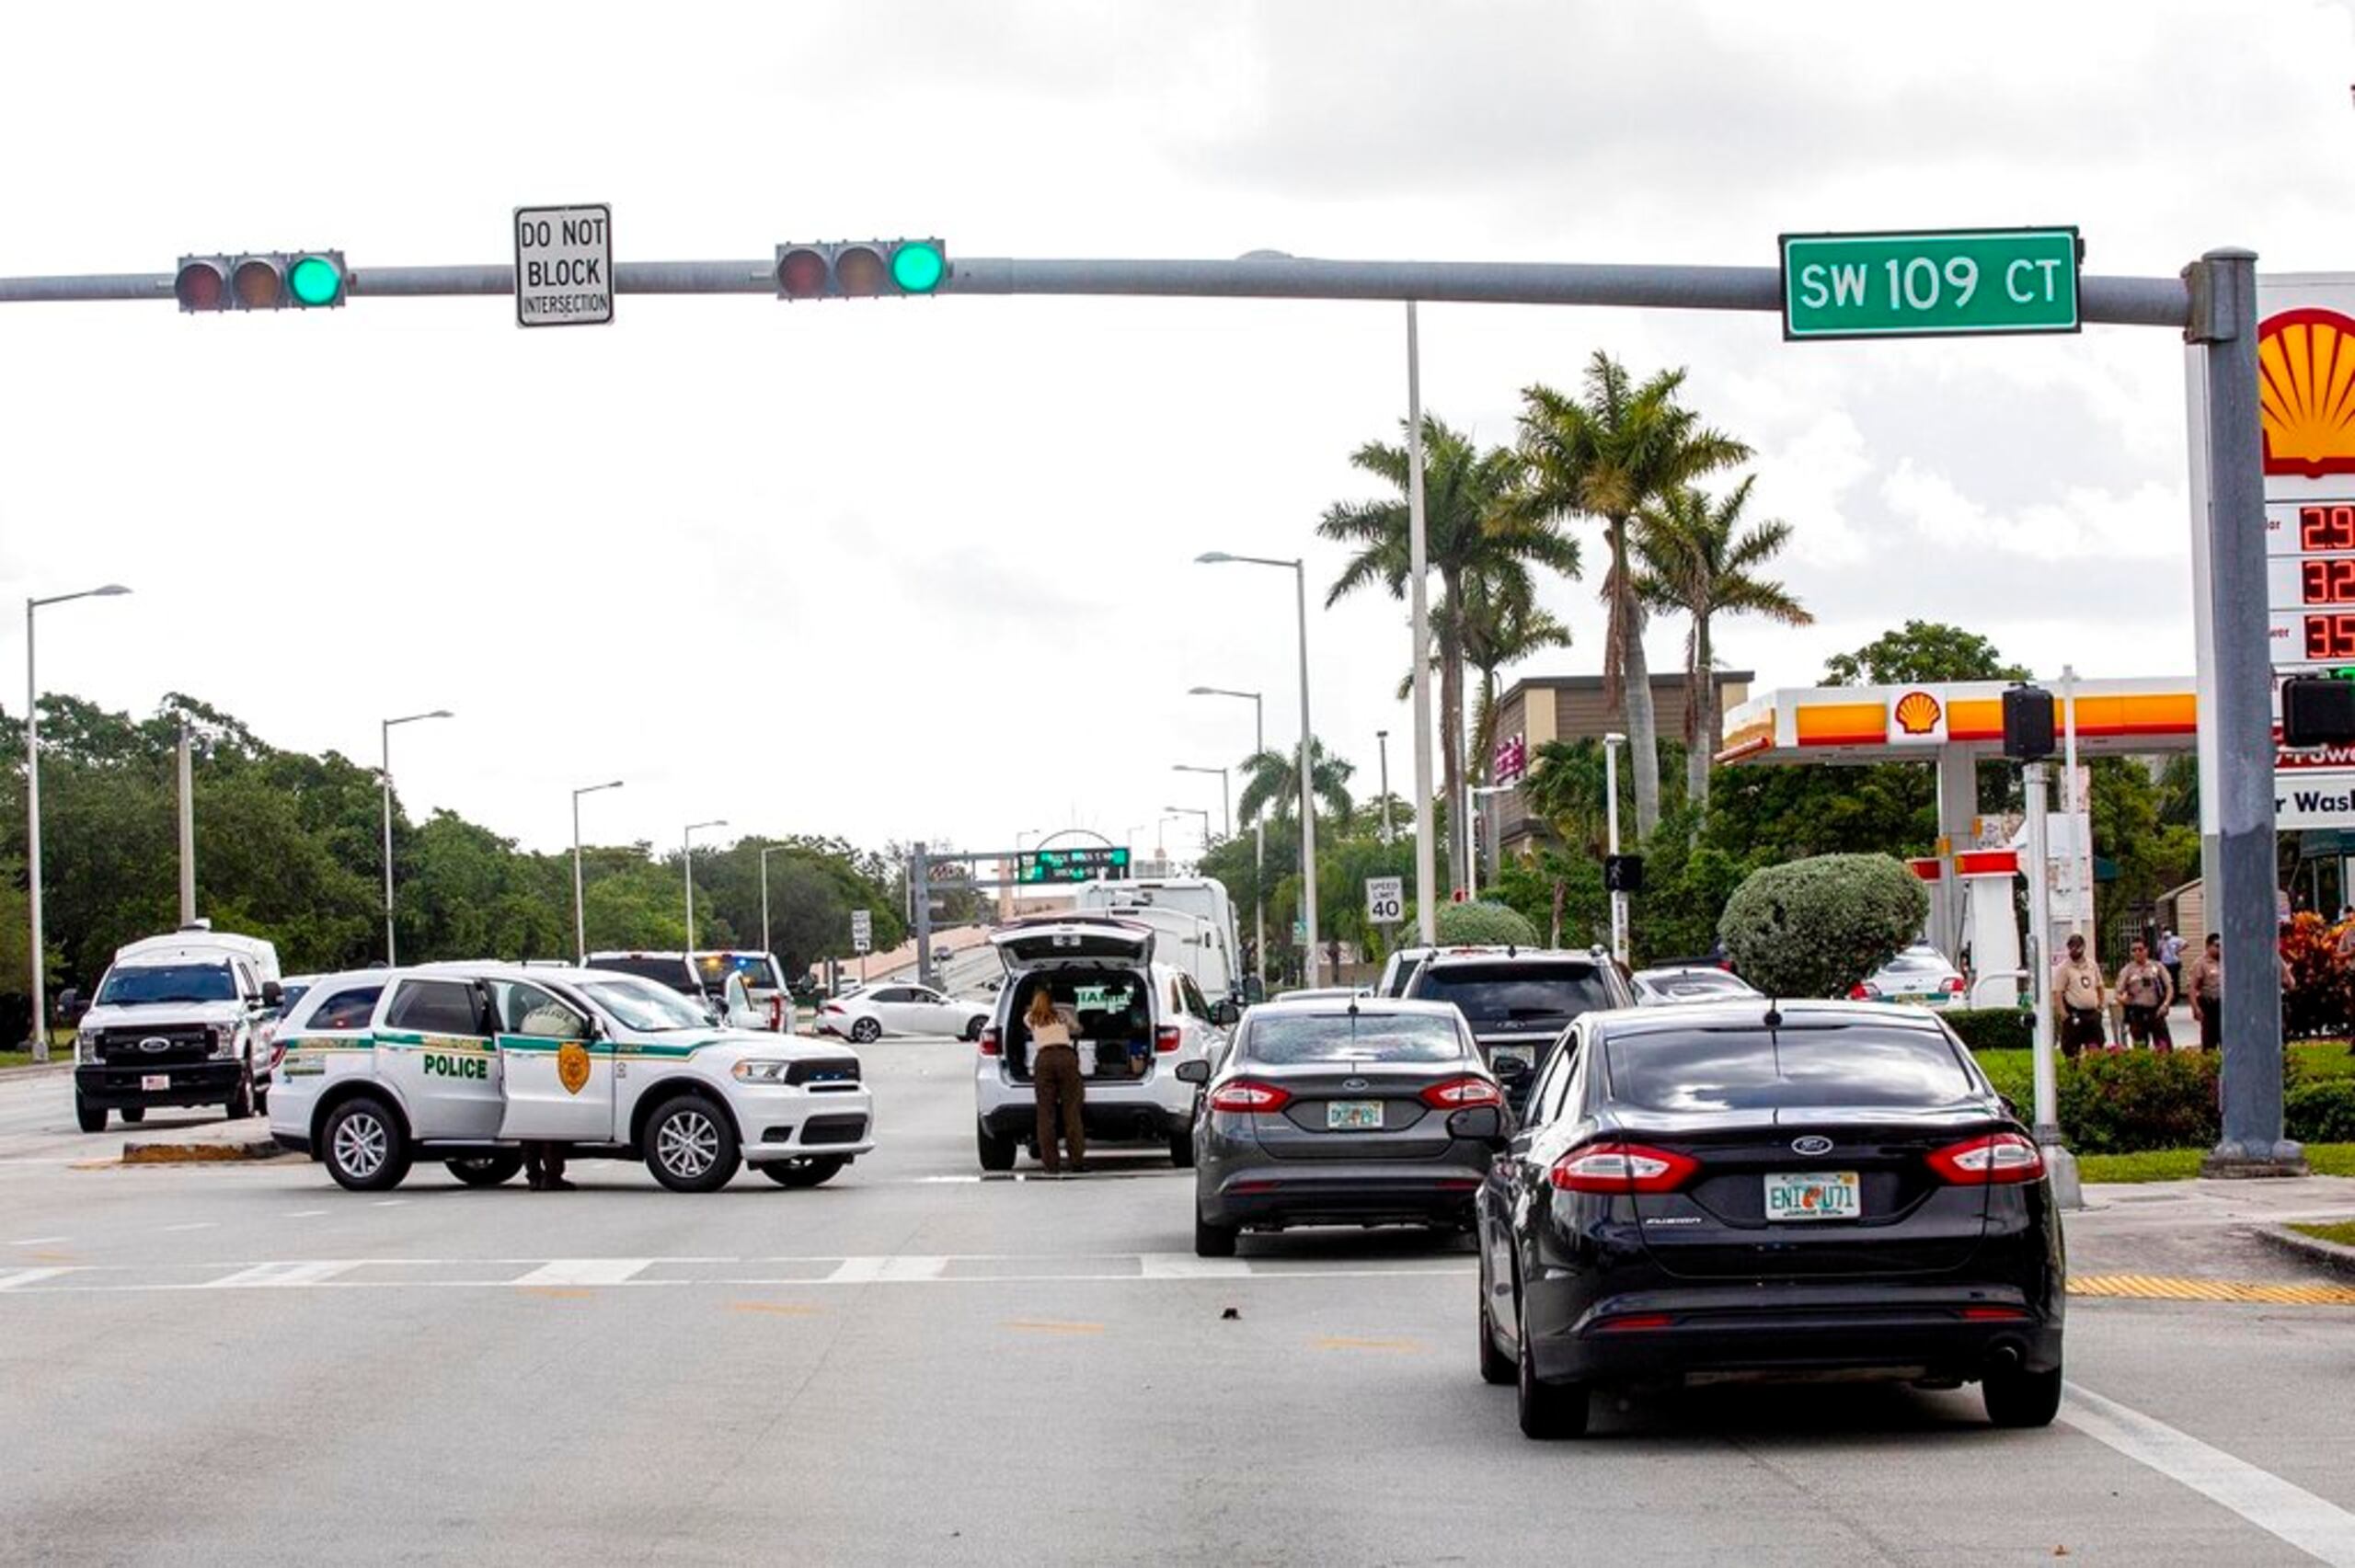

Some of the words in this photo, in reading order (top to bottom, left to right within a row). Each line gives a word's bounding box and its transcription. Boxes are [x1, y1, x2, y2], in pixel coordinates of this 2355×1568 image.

[522, 221, 550, 247] DO
[563, 219, 604, 246] NOT
[528, 258, 601, 287] BLOCK
[1800, 264, 1867, 309] SW
[1885, 257, 1979, 311] 109
[2005, 259, 2061, 303] CT
[523, 294, 608, 314] INTERSECTION
[1372, 900, 1399, 917] 40
[423, 1054, 488, 1080] POLICE
